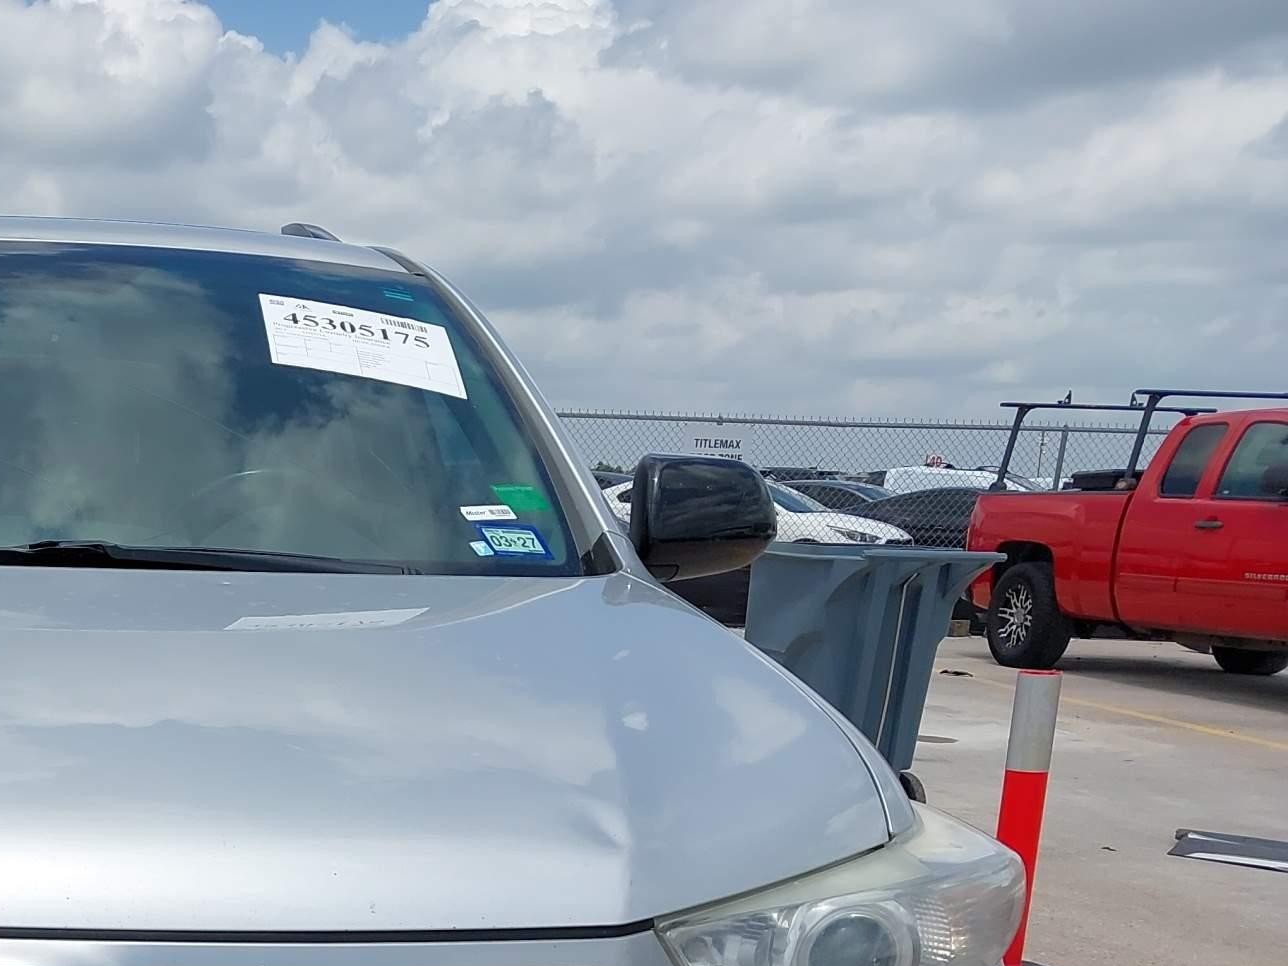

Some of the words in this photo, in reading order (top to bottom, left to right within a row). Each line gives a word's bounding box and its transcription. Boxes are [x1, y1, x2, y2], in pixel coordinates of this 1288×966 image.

[283, 312, 430, 349] 45305175
[694, 438, 742, 449] TITLEMAX
[490, 535, 512, 547] 03
[517, 537, 536, 548] 27
